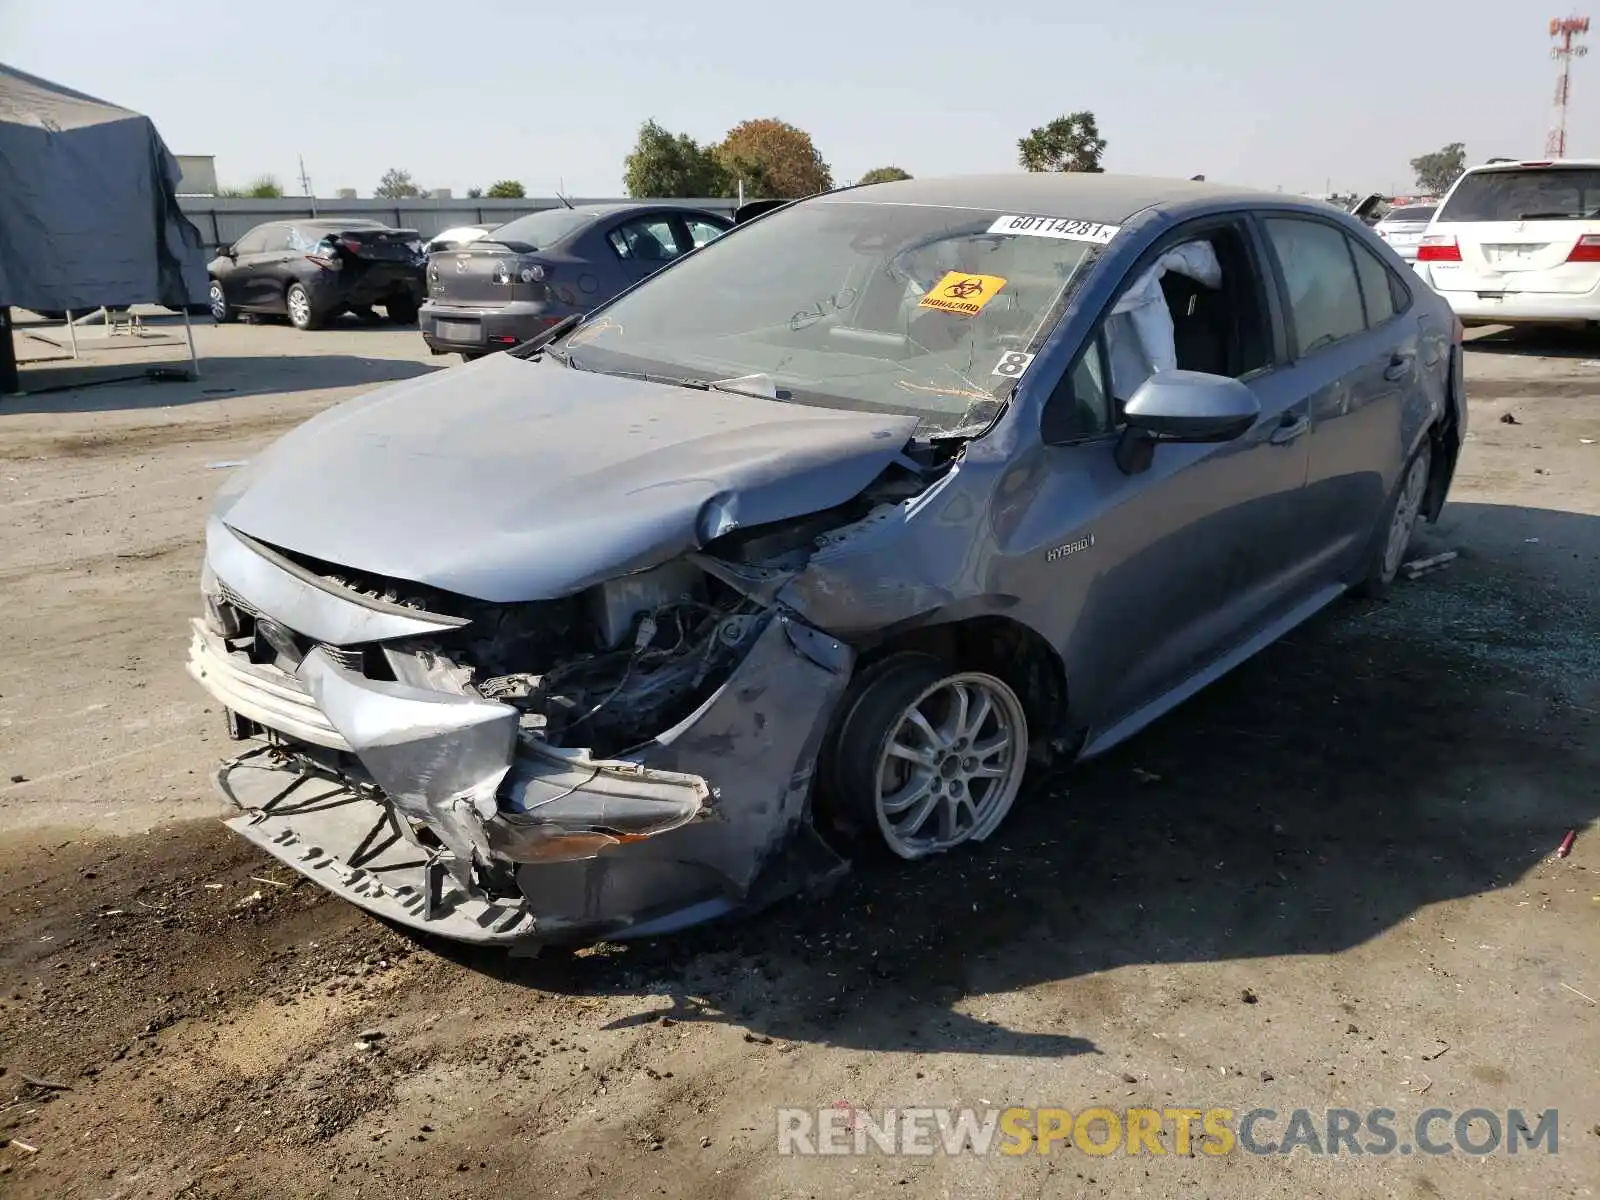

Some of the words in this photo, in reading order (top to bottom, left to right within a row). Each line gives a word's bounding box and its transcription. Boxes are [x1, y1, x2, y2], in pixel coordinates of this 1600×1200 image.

[921, 297, 980, 312] BIOHAZARD
[997, 353, 1028, 375] 8
[1047, 537, 1089, 562] HYBRID
